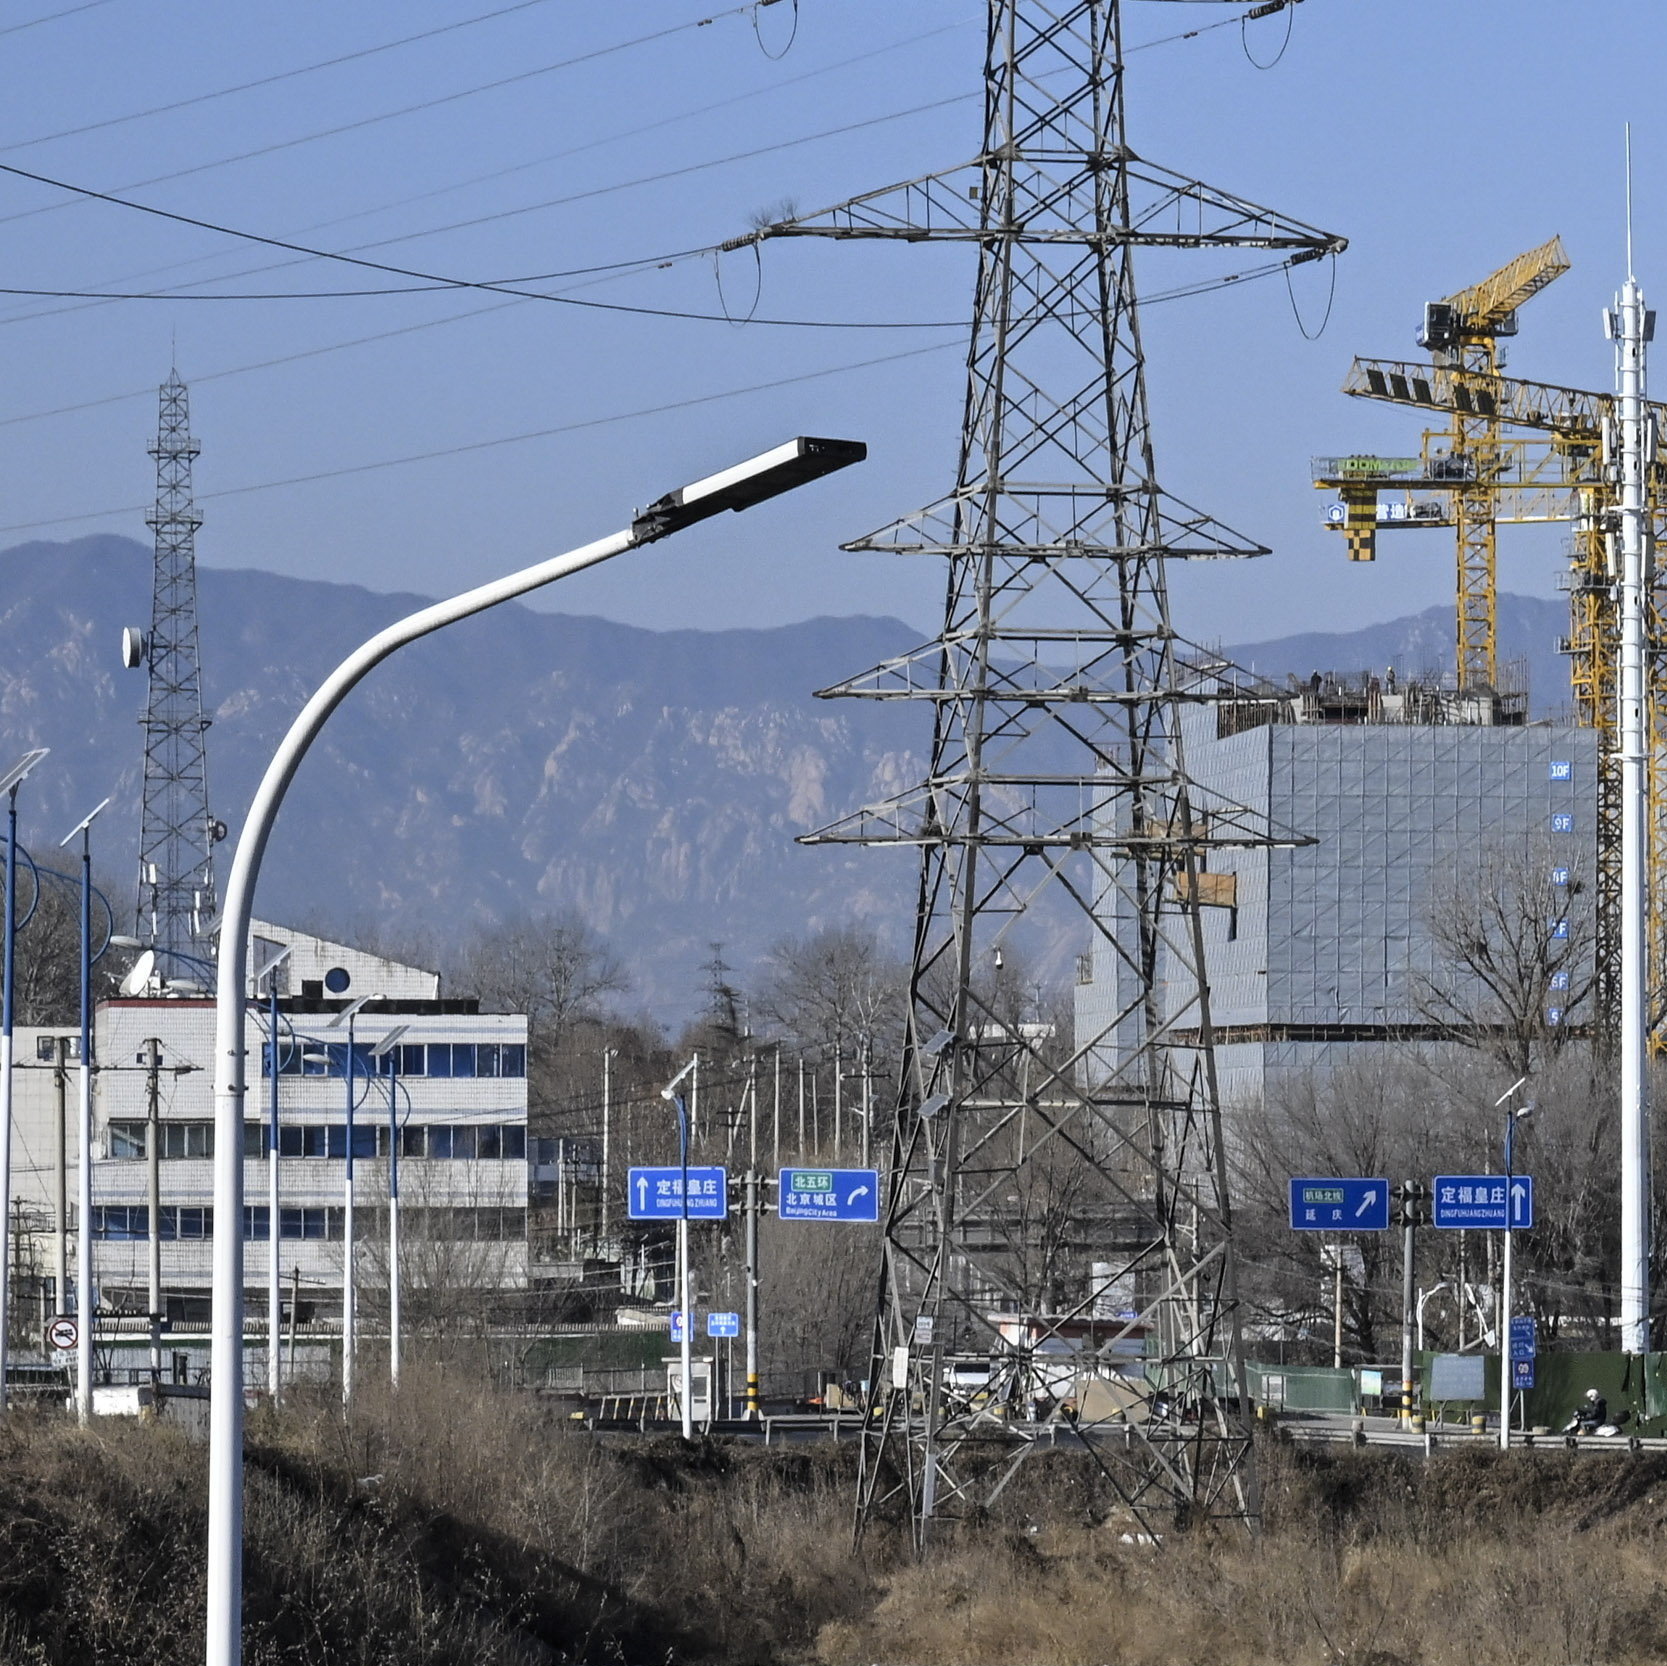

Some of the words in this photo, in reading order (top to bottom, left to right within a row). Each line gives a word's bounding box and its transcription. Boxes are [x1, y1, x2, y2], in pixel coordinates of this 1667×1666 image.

[1551, 765, 1569, 777] 10F
[1554, 818, 1570, 830] 9F
[656, 1179, 717, 1196] 定福皇庄
[794, 1175, 829, 1189] 北五环
[785, 1192, 837, 1207] 北京城区
[1440, 1186, 1505, 1204] 定福皇庄
